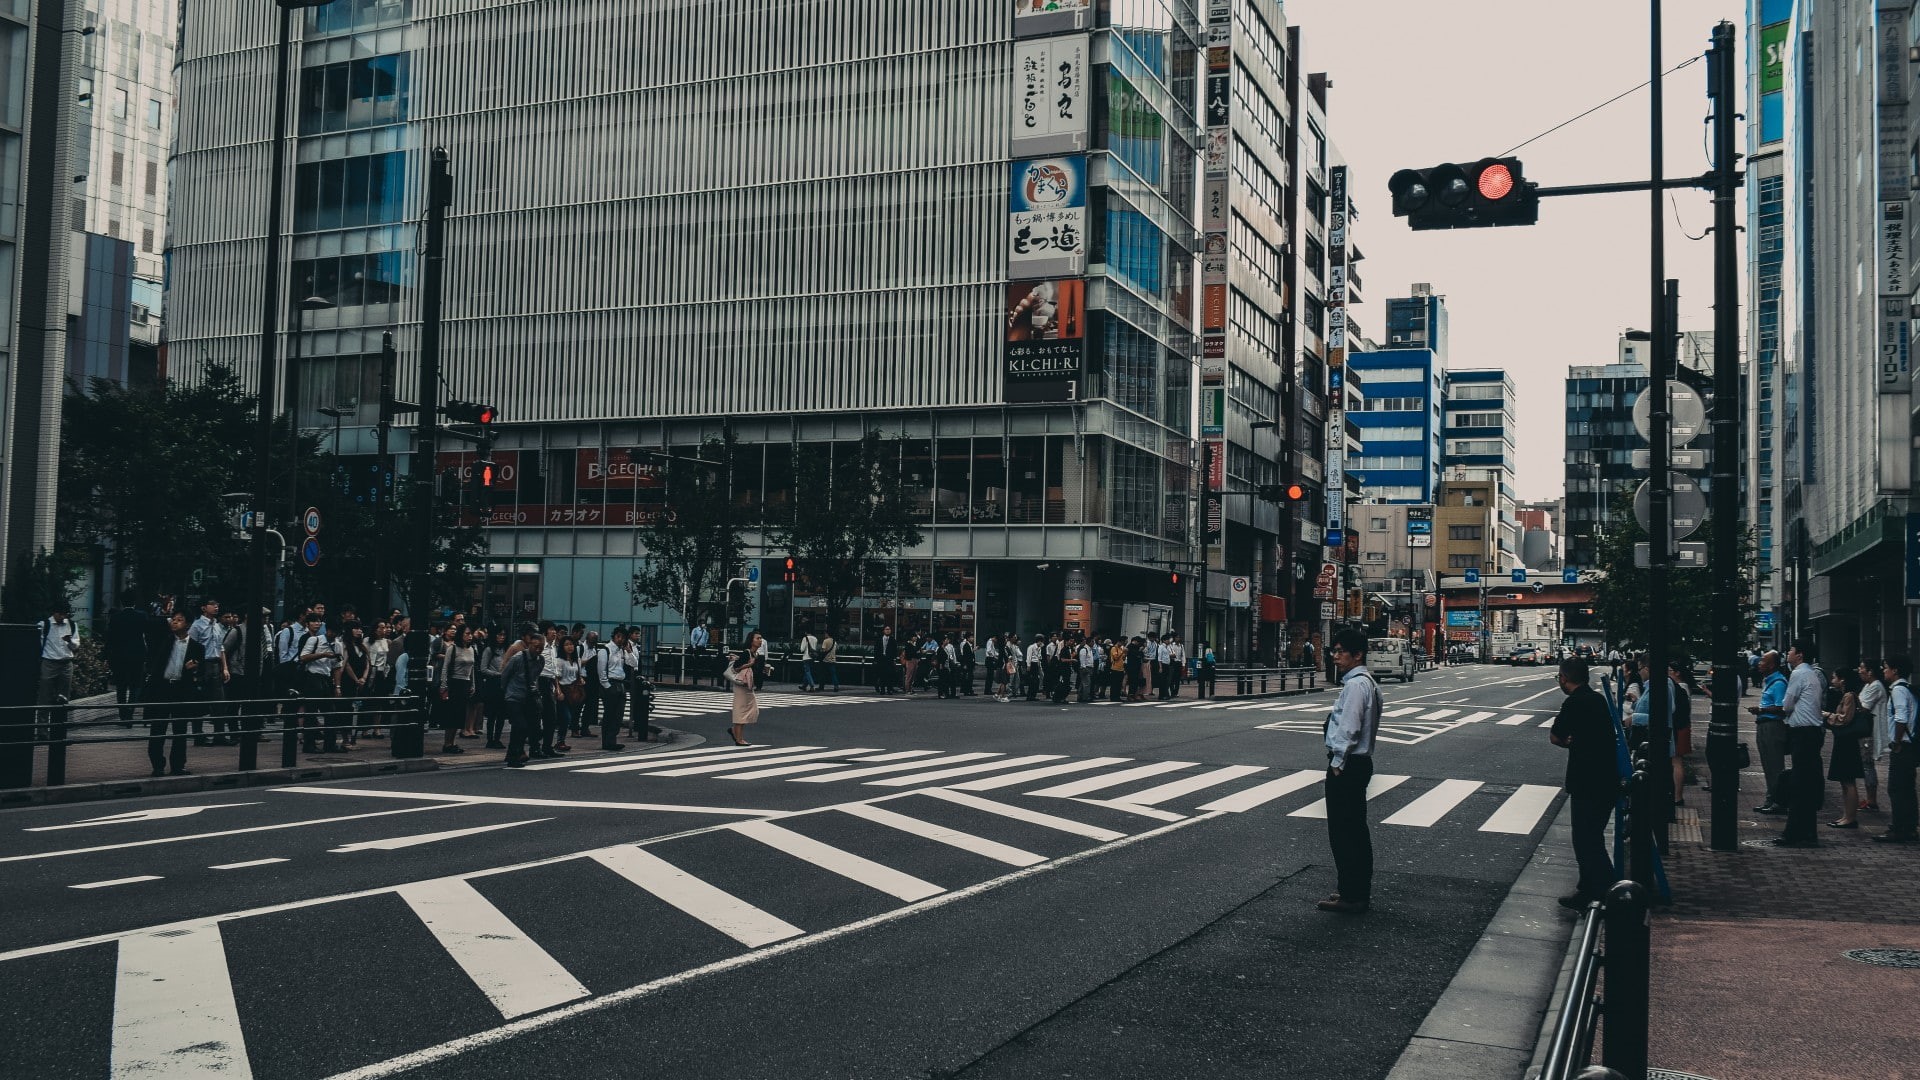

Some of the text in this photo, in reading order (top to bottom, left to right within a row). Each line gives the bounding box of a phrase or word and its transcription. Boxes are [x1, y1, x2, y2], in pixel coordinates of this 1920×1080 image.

[1883, 344, 1898, 384] ワーロン
[1066, 380, 1076, 400] 3
[588, 463, 617, 479] BG
[308, 516, 317, 528] 40
[550, 509, 601, 521] カラオケ
